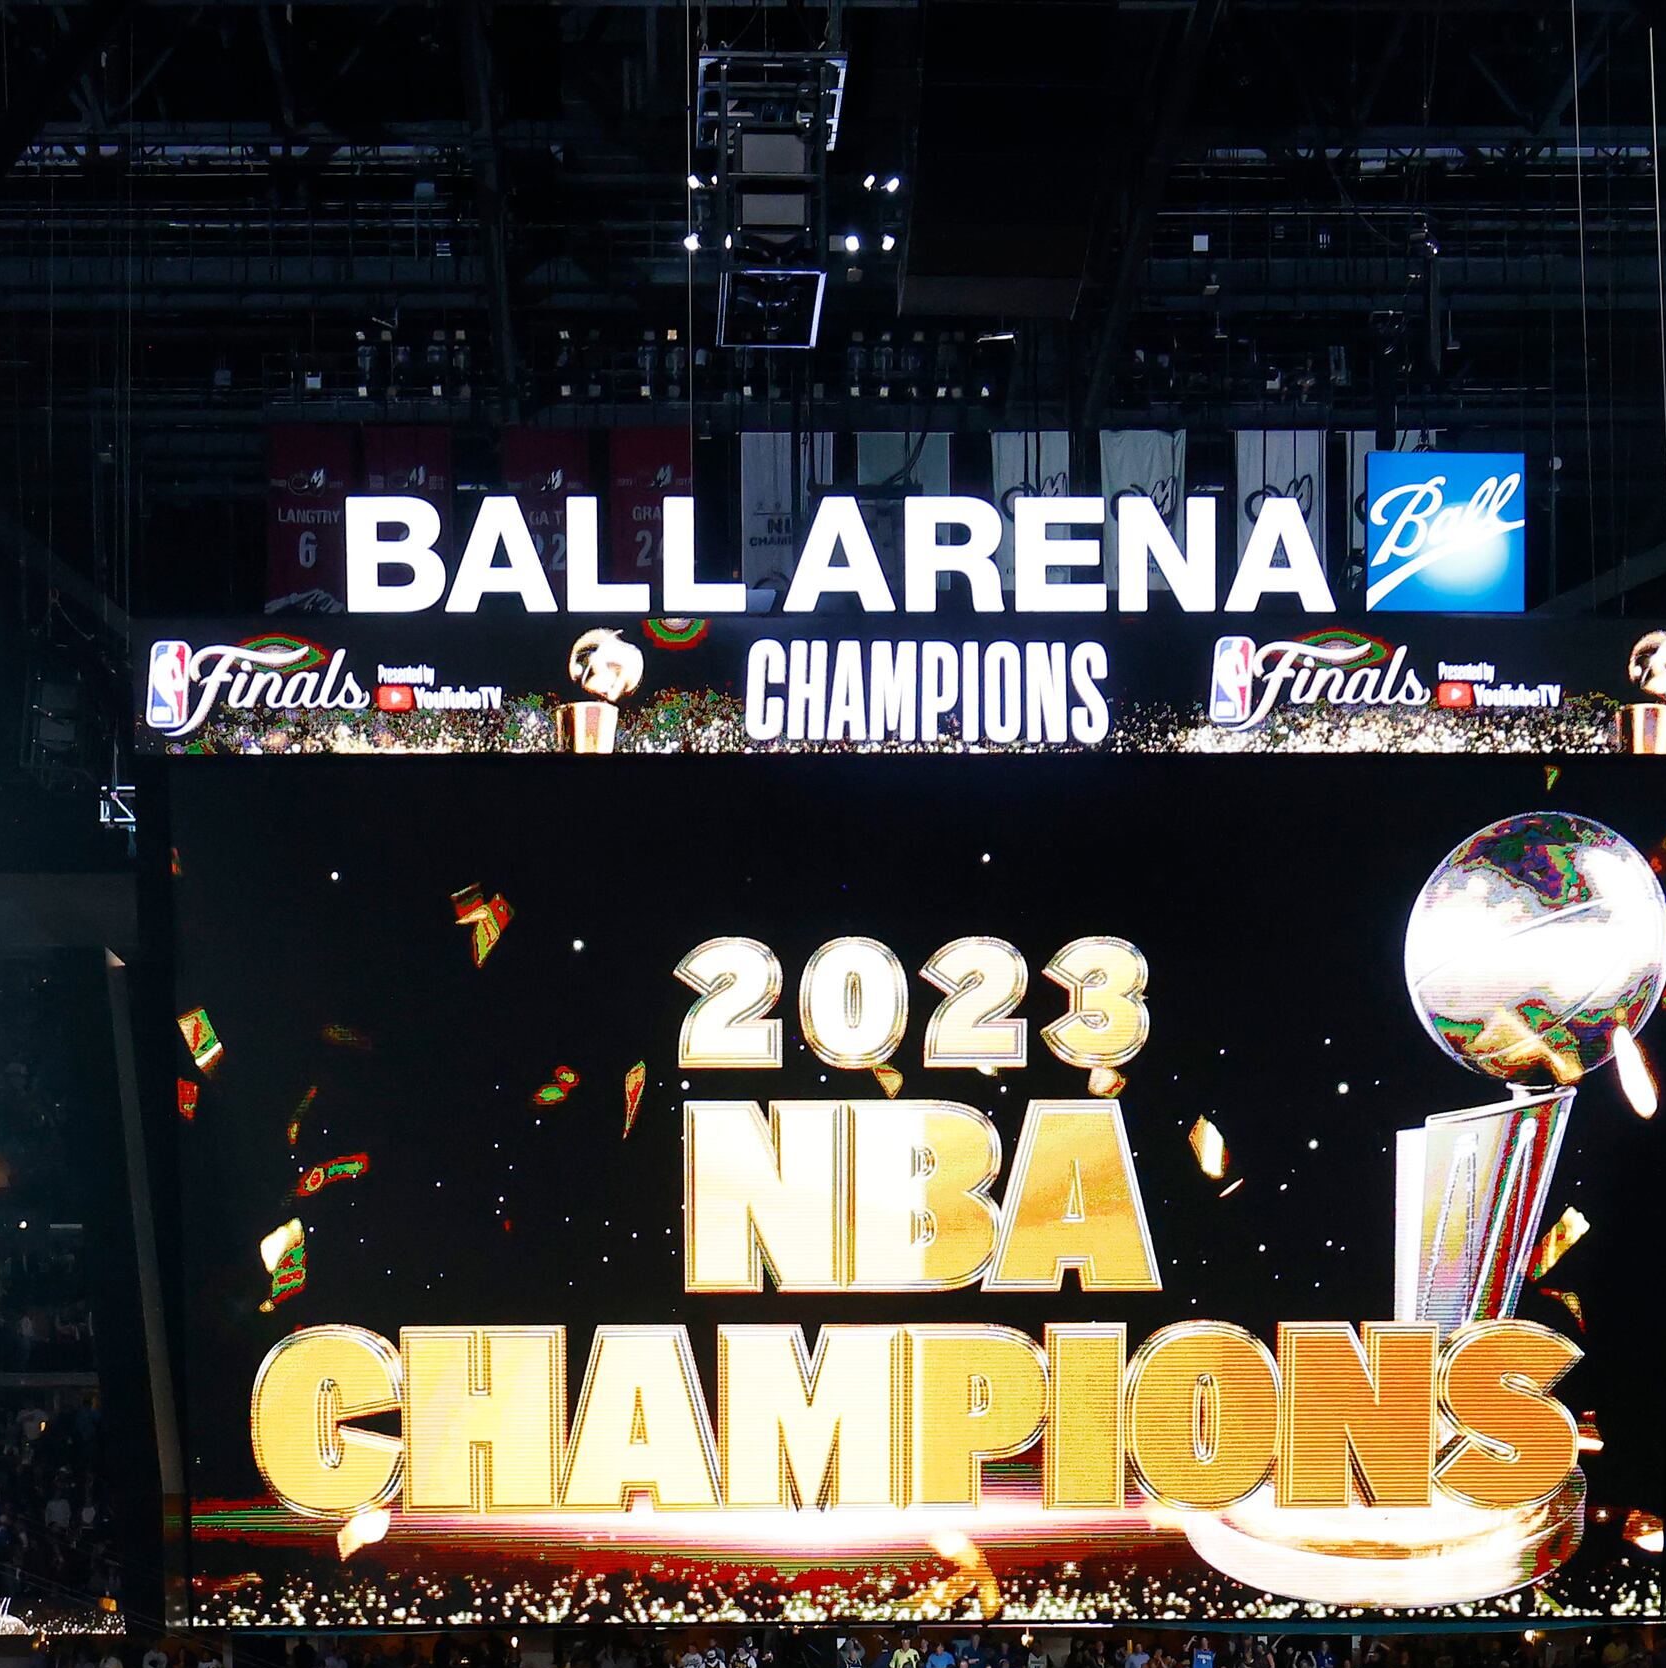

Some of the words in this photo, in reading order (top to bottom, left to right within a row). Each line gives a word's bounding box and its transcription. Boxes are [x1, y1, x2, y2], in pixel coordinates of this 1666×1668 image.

[298, 530, 317, 569] 6
[343, 494, 747, 613] BALL
[781, 494, 1337, 613] ARENA
[1369, 471, 1525, 572] Ball
[164, 643, 371, 737] Finals
[420, 665, 436, 687] by
[746, 639, 1108, 744] CHAMPIONS
[1237, 640, 1431, 732] Finals
[676, 935, 1149, 1069] 2023
[684, 1098, 1163, 1294] NBA
[250, 1318, 1585, 1516] CHAMPIONS
